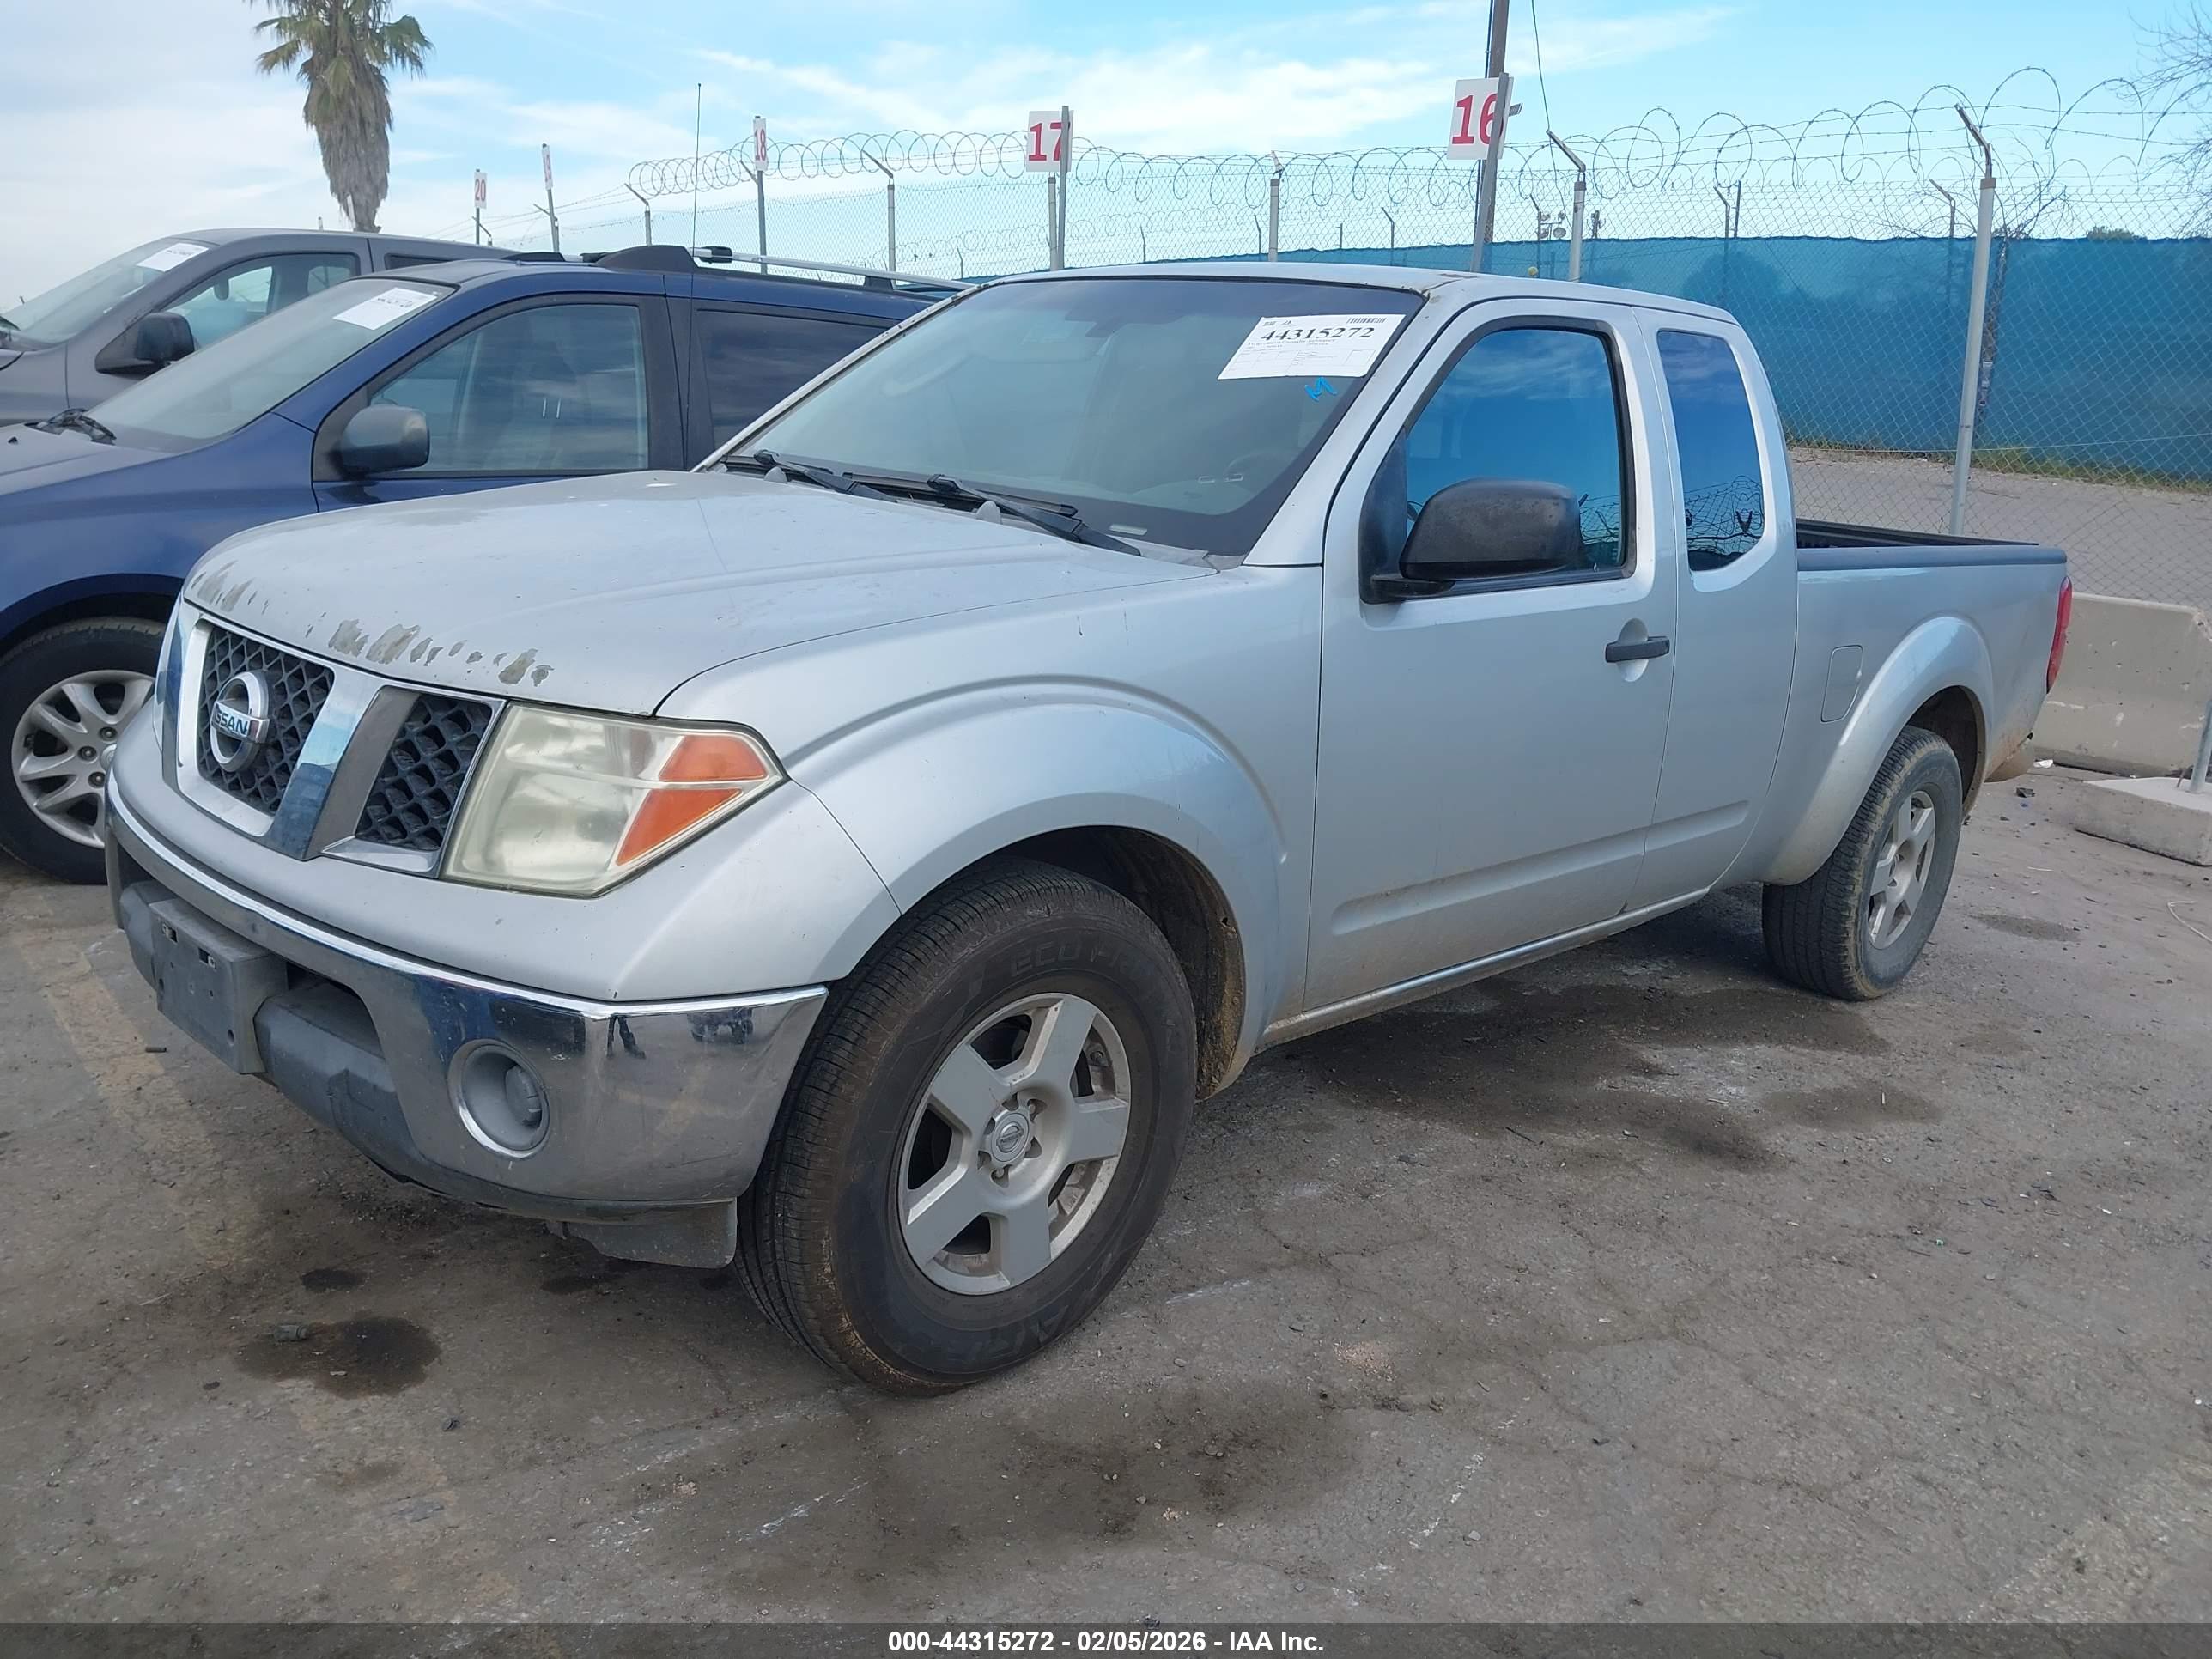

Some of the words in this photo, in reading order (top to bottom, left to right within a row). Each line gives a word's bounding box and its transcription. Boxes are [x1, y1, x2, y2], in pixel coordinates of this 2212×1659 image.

[1452, 93, 1504, 144] 16
[755, 129, 766, 161] 18
[1029, 122, 1070, 161] 17
[475, 178, 486, 202] 20
[1261, 327, 1374, 340] 44315272
